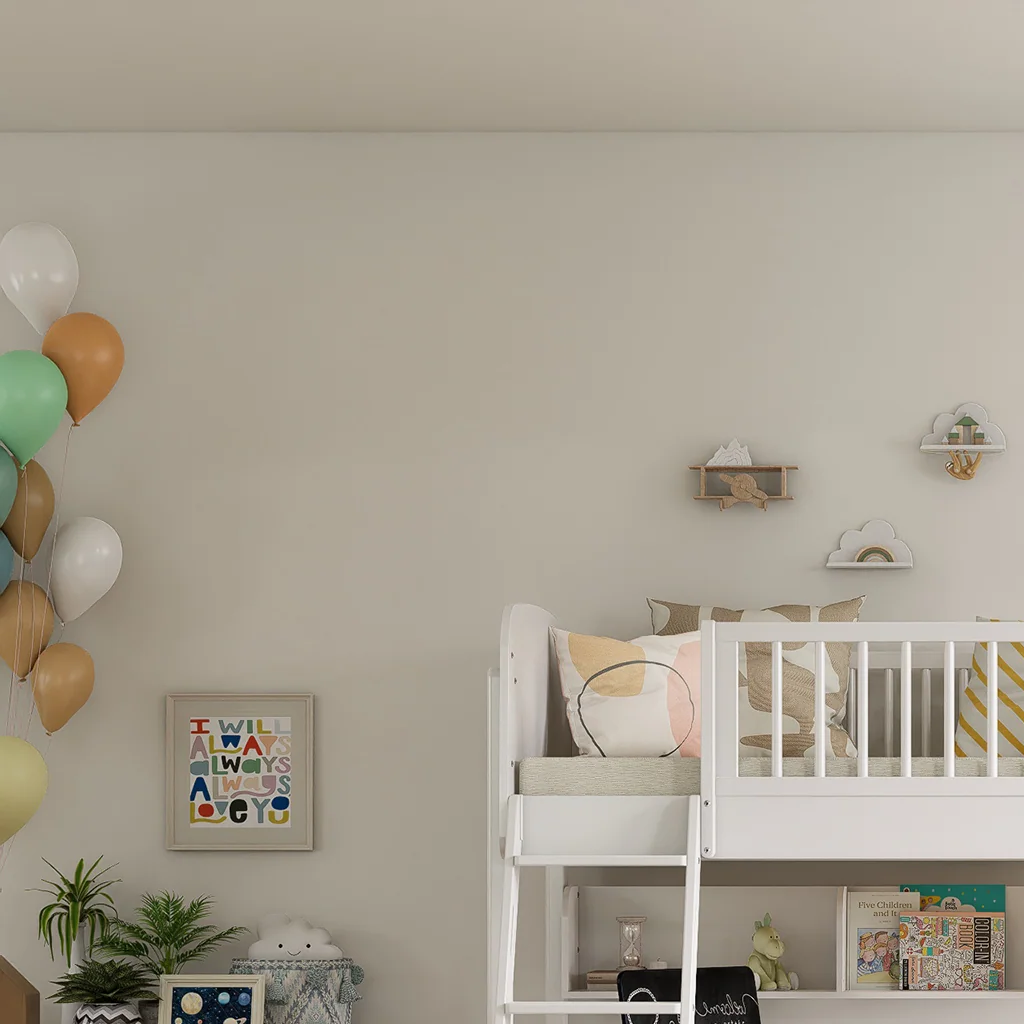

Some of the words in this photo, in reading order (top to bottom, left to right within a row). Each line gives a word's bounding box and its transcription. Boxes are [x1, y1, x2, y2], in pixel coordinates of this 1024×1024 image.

[190, 719, 210, 734] I
[218, 719, 291, 734] WILL
[858, 901, 875, 909] Five
[876, 901, 912, 909] Children
[959, 924, 974, 949] BOOK
[975, 918, 990, 961] COLOR-IN
